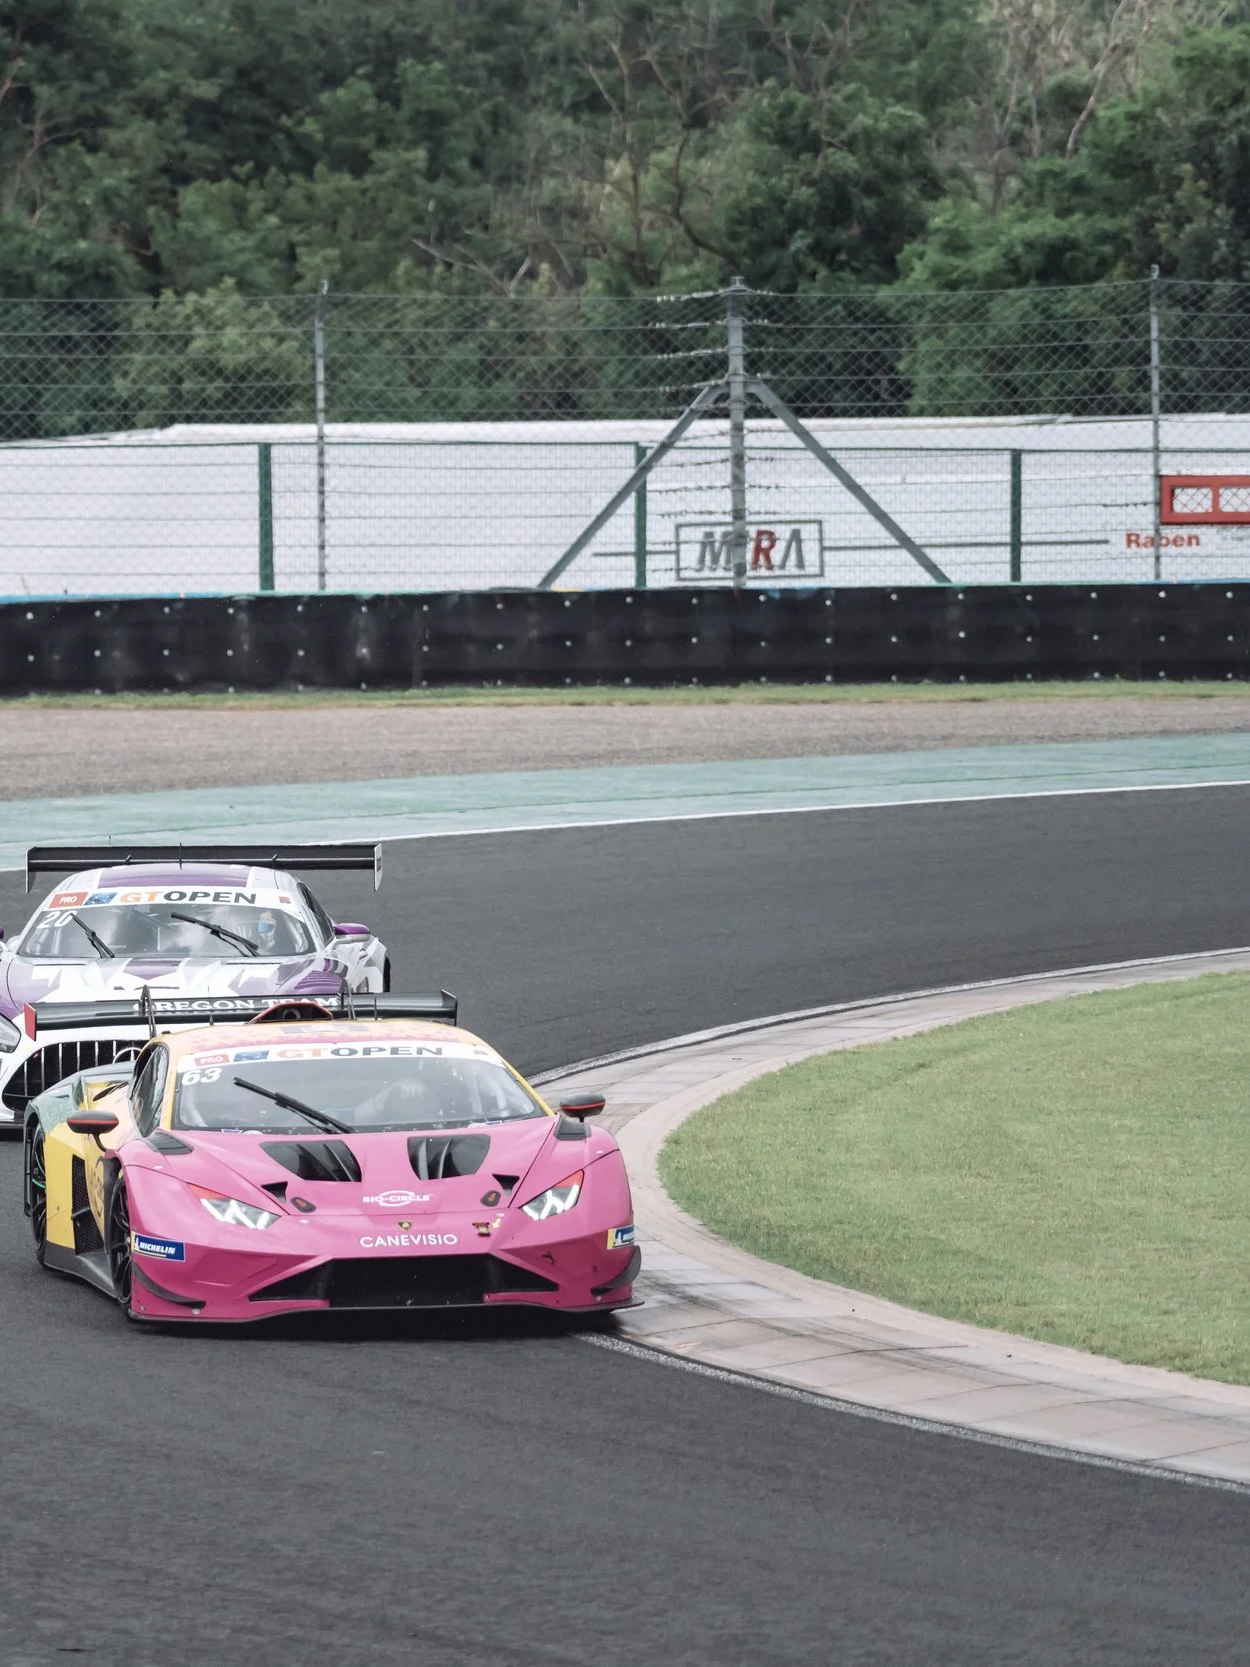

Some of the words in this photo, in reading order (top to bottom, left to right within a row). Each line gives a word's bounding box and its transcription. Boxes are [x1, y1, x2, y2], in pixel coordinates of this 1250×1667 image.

[695, 529, 806, 572] MRA
[59, 895, 78, 905] PRO
[36, 910, 78, 929] 20
[200, 1055, 224, 1065] PRO
[181, 1067, 223, 1086] 63
[139, 1241, 176, 1255] MICHELIN
[359, 1233, 458, 1248] CANEVISIO
